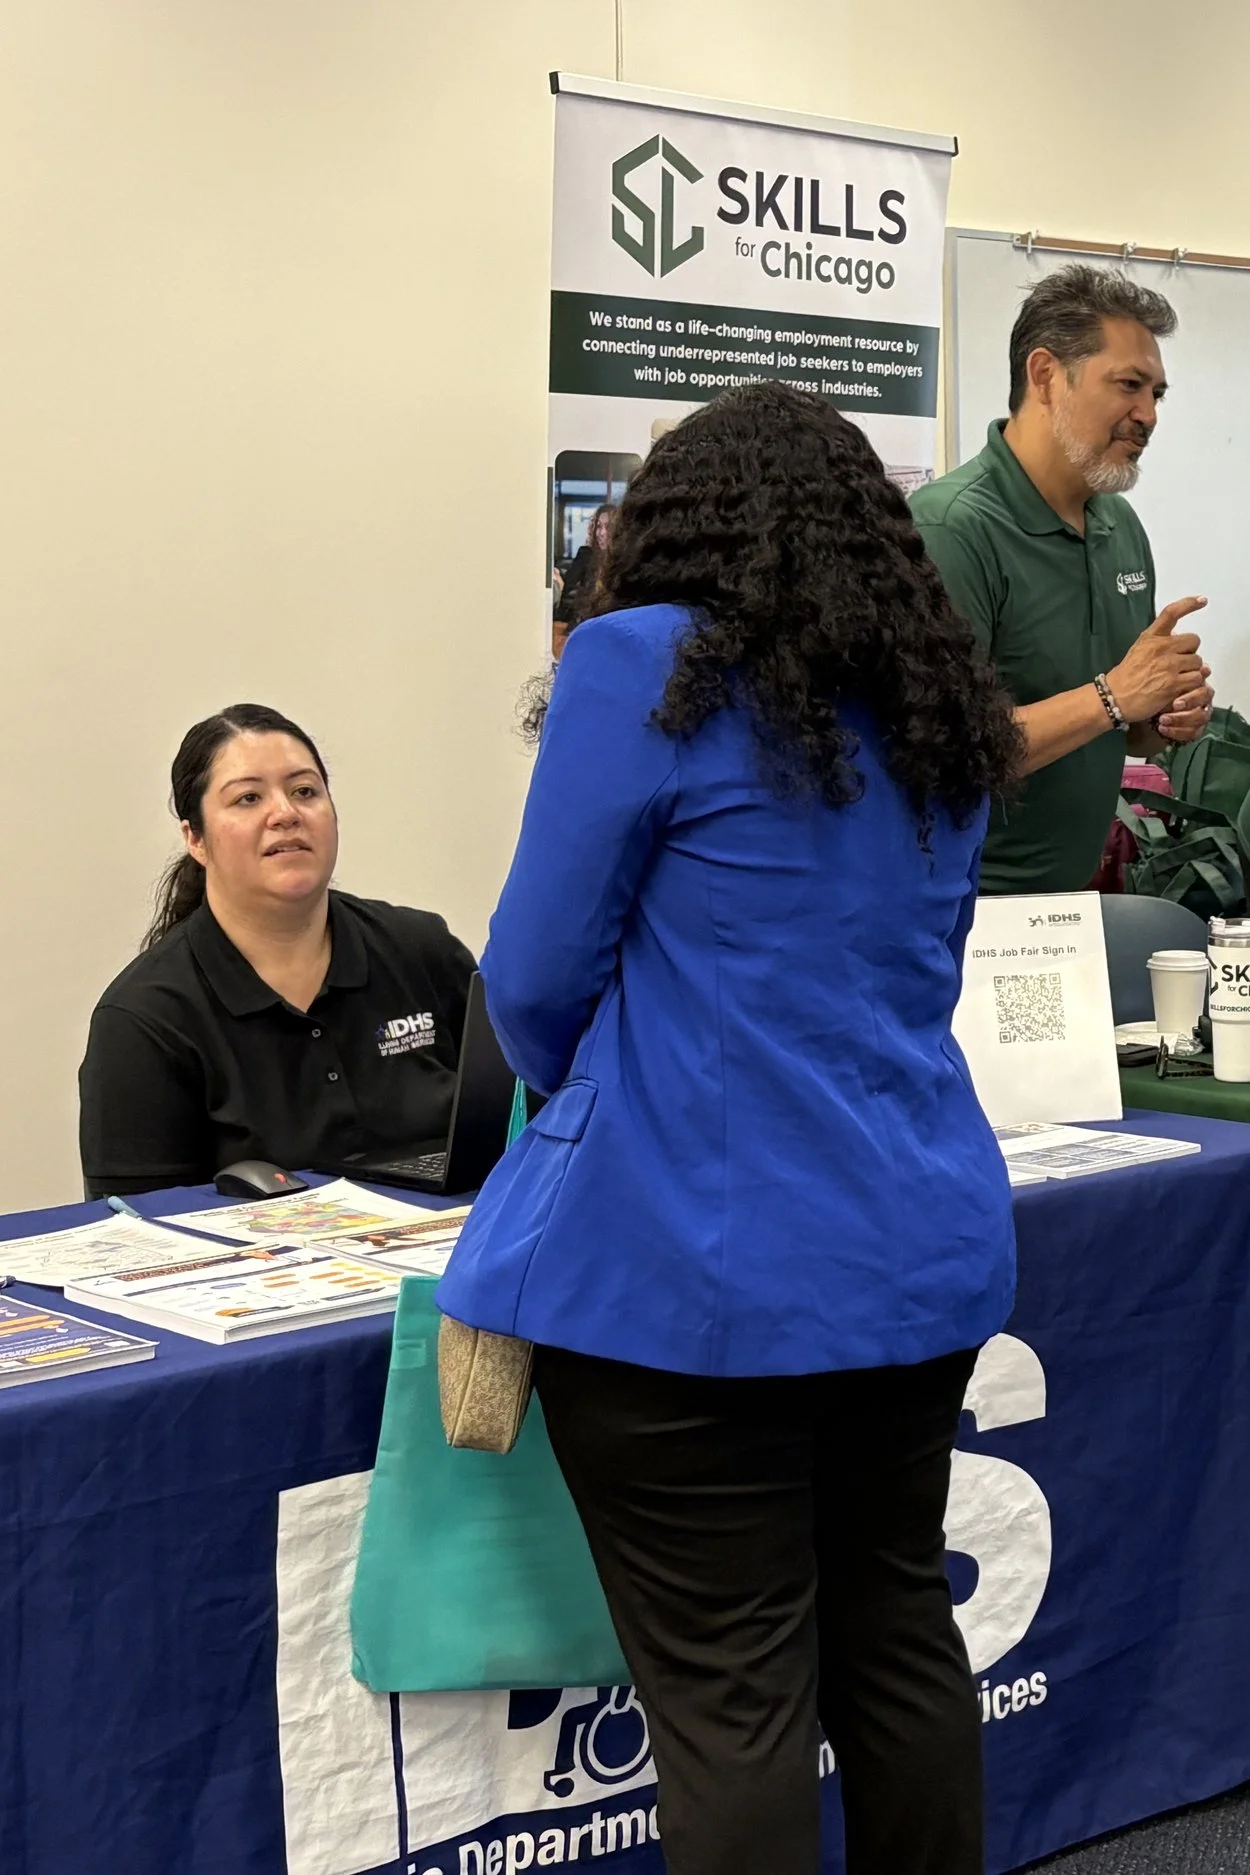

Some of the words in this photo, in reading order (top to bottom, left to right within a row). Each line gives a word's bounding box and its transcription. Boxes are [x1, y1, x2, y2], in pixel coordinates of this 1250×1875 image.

[717, 166, 907, 245] SKILLS
[735, 236, 757, 258] for
[760, 240, 896, 295] Chicago
[589, 311, 613, 328] We
[616, 315, 652, 331] stand
[656, 320, 672, 333] as
[675, 322, 685, 334] a
[688, 319, 772, 344] life-changing
[775, 330, 852, 348] employment
[854, 338, 904, 353] resource
[906, 340, 920, 356] by
[582, 338, 656, 359] connecting
[659, 344, 775, 366] underrepresented
[777, 351, 798, 369] job
[800, 356, 849, 372] seekers
[852, 359, 864, 373] to
[866, 361, 923, 378] employers
[634, 365, 662, 382] with
[664, 367, 687, 385] job
[821, 379, 883, 398] industries.
[1047, 913, 1081, 923] IDHS
[972, 948, 997, 958] IDHS
[1000, 948, 1018, 957] Job
[1021, 946, 1039, 956] Fair
[1042, 945, 1064, 956] Sign
[1067, 945, 1076, 954] In
[387, 1012, 435, 1039] IDHS
[977, 1671, 1048, 1724] ices
